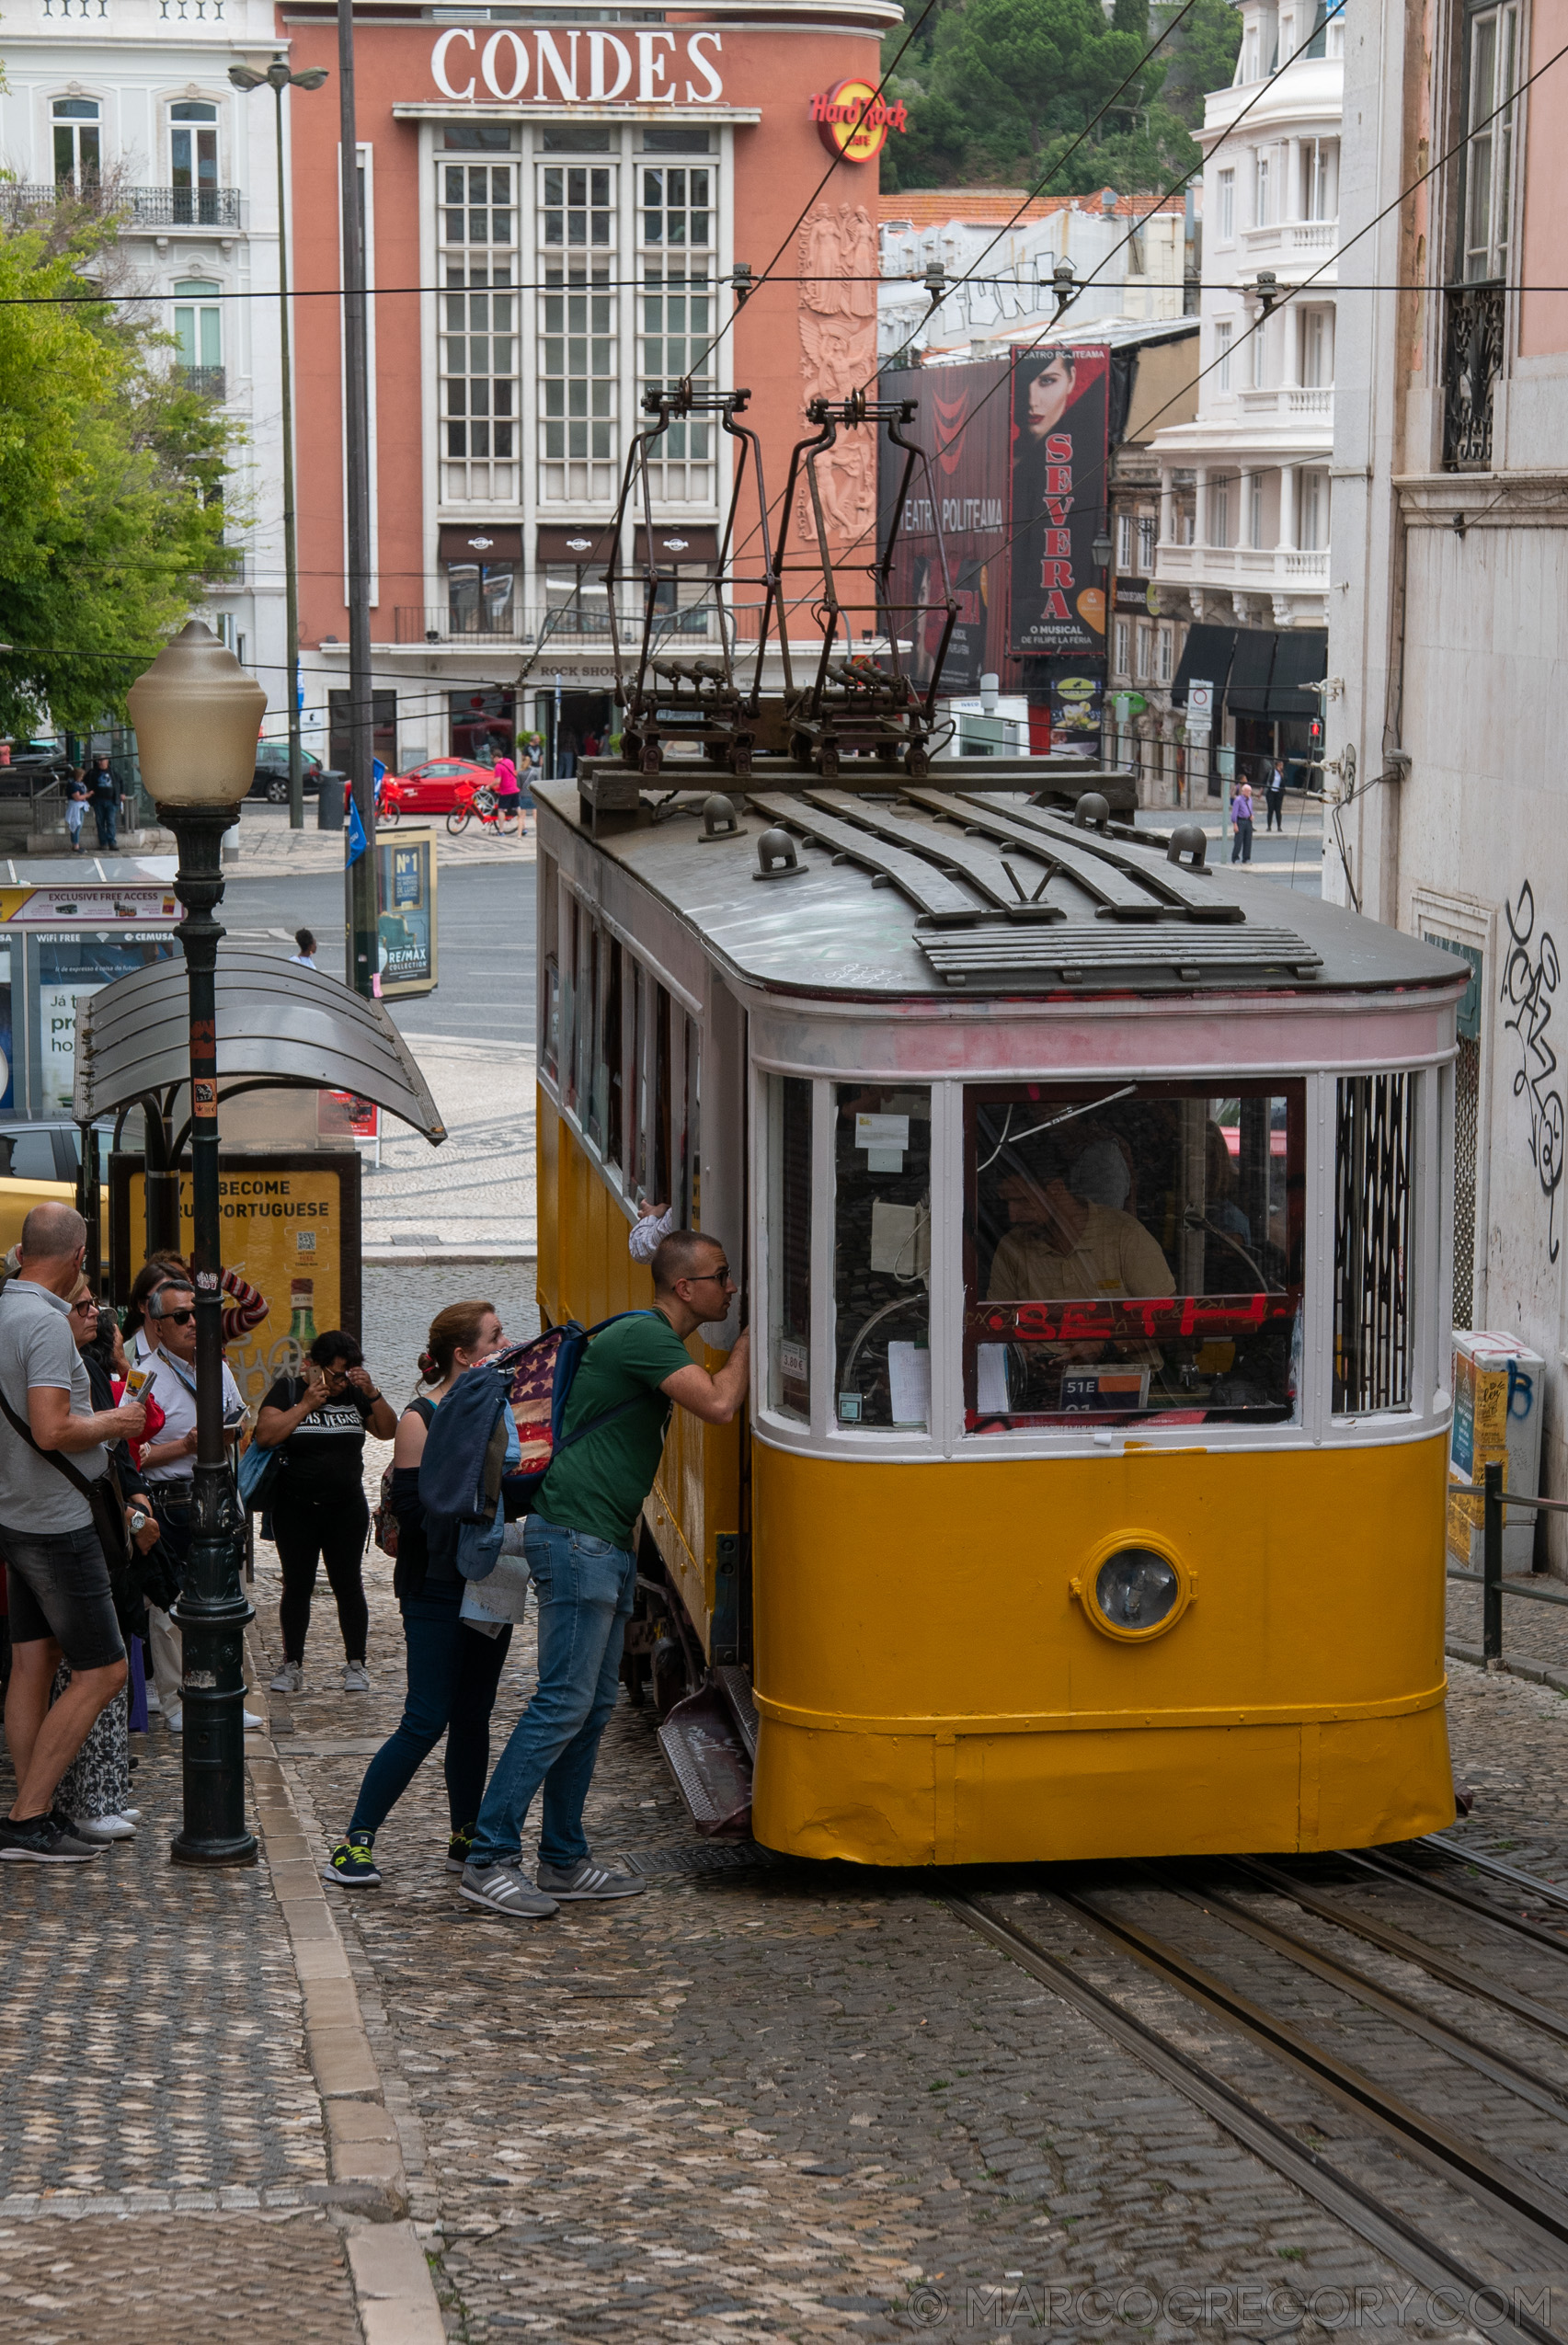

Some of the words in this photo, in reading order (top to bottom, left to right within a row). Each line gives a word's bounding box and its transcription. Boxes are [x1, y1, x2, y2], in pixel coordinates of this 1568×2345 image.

[431, 29, 723, 103] CONDES
[809, 94, 861, 124] Hard
[861, 97, 908, 132] Rock
[1017, 350, 1054, 360] TEATRO
[943, 498, 1003, 533] POLITEAMA
[1040, 433, 1075, 620] SEVERA
[1030, 625, 1038, 635] O
[1039, 625, 1083, 635] MUSICAL
[1021, 636, 1031, 645] DE
[541, 667, 578, 677] ROCK
[49, 893, 97, 901] EXCLUSIVE
[100, 893, 121, 901] FREE
[124, 892, 158, 900] ACCESS
[36, 934, 57, 943] WiFi
[135, 932, 175, 942] CEMUSA
[389, 948, 427, 963] RE/MAX
[51, 995, 66, 1007] Já
[220, 1181, 291, 1195] BECOME
[1067, 1381, 1095, 1393] 51E
[323, 1412, 360, 1426] VEGAS
